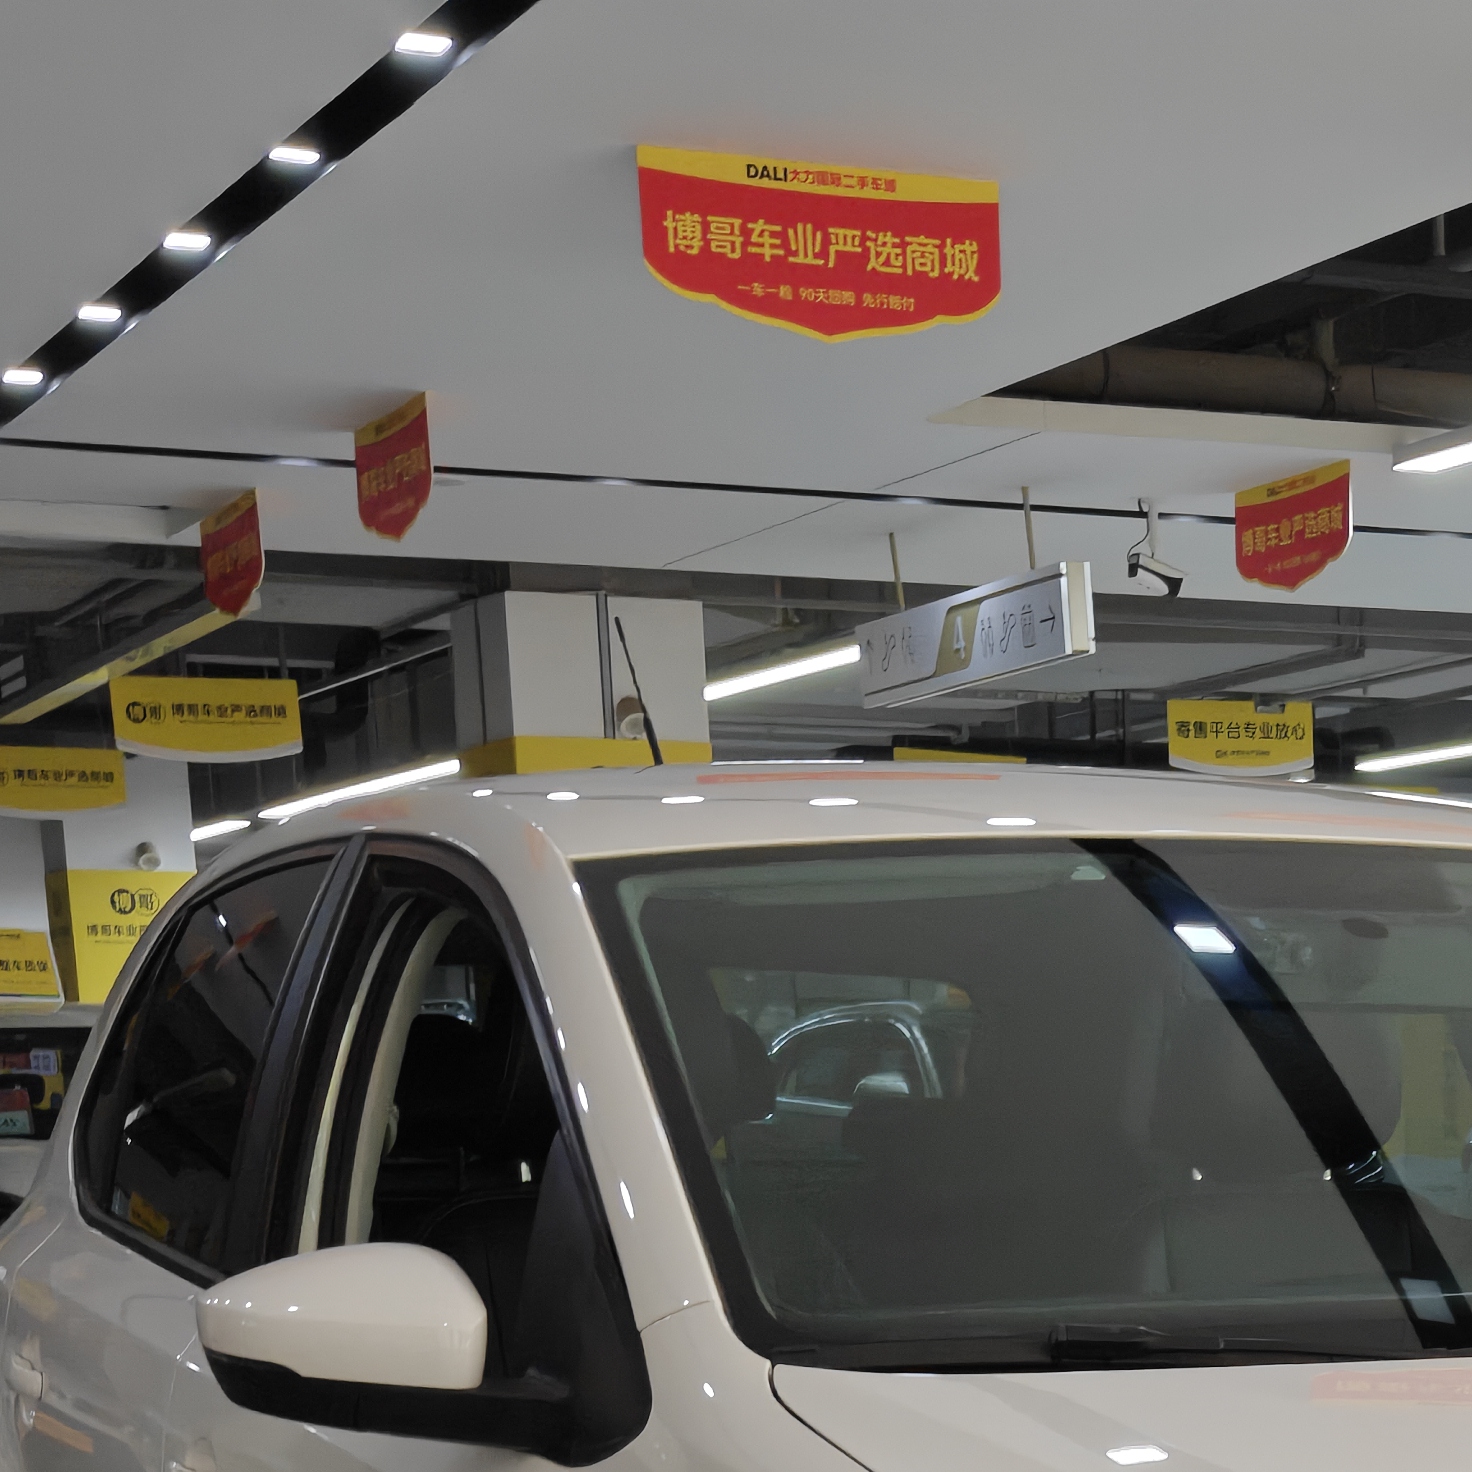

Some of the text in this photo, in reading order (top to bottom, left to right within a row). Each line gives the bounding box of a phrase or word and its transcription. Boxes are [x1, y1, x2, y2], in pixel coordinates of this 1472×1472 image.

[746, 164, 788, 182] DALI
[663, 209, 980, 283] 博哥车业严选商城
[953, 615, 966, 661] 4
